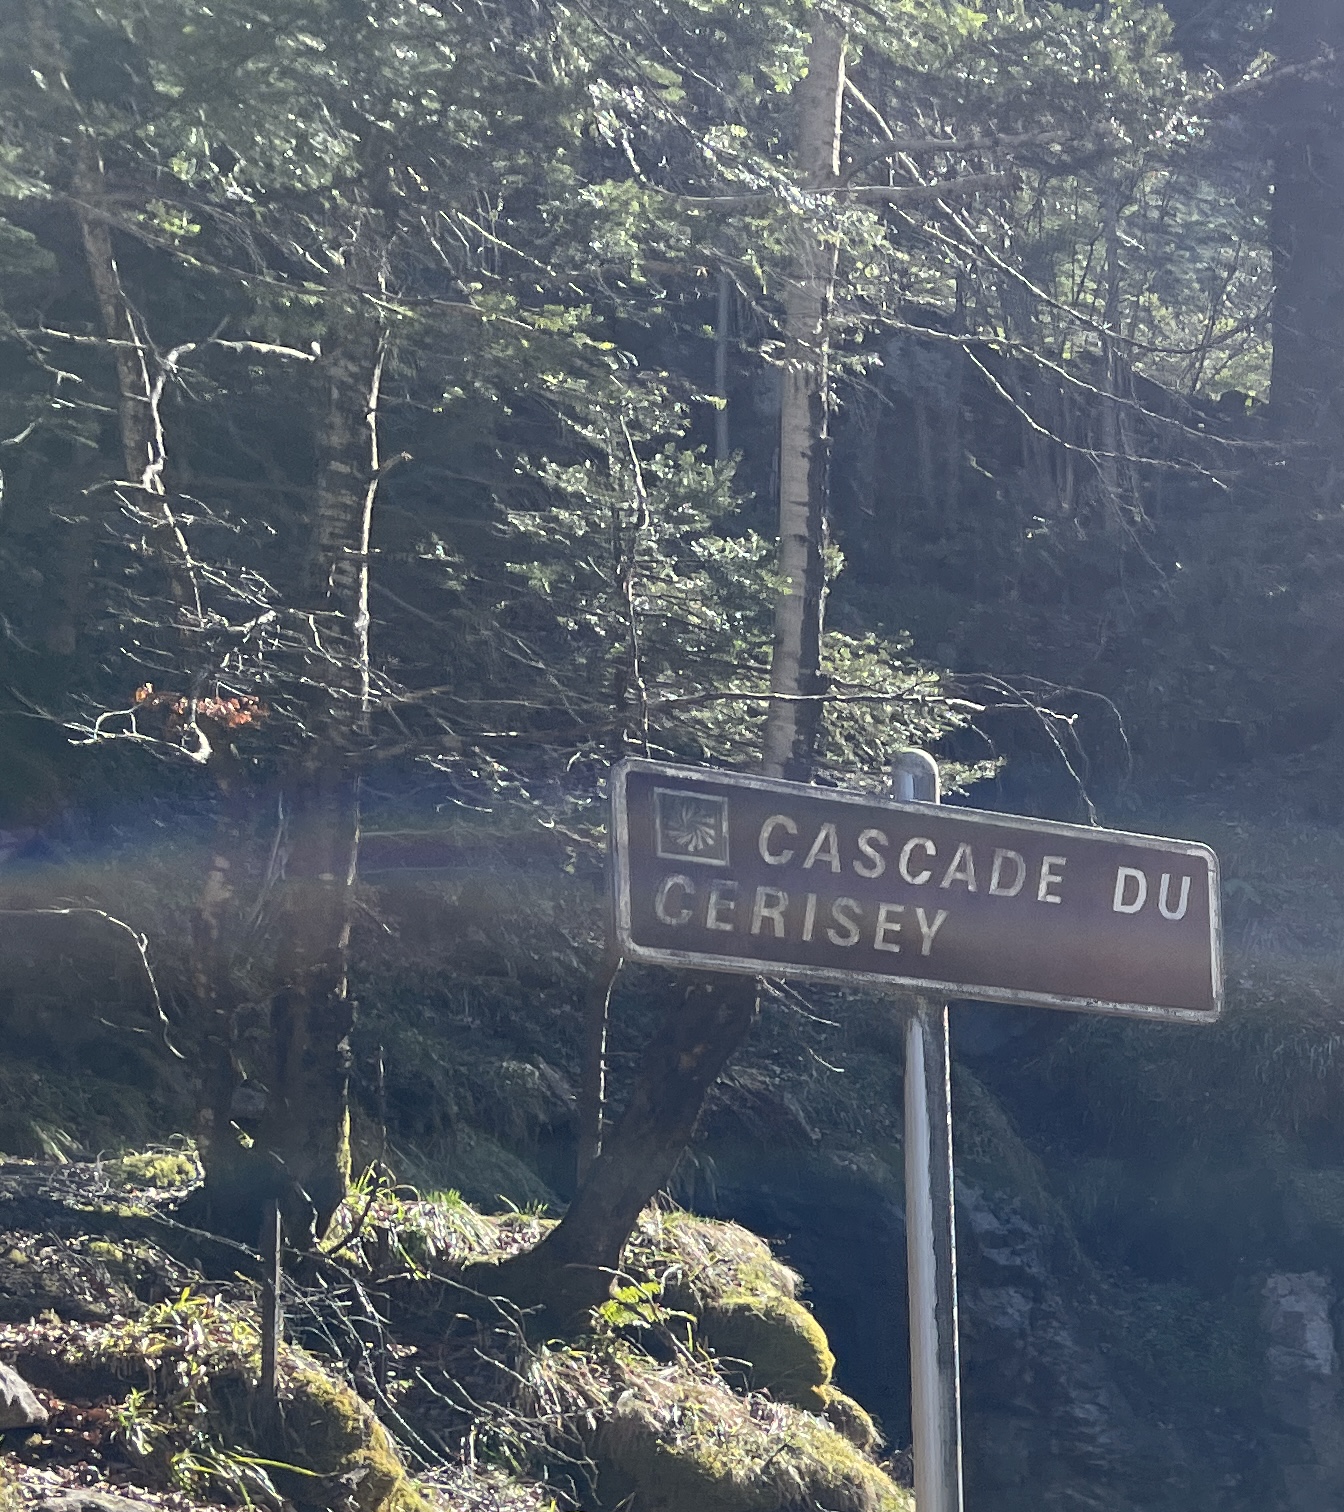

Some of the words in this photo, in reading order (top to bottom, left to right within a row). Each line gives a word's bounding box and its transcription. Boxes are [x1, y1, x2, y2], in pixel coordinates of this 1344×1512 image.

[757, 814, 1068, 905] CASCADE
[1112, 866, 1192, 921] DU
[654, 874, 949, 957] CERISEY
